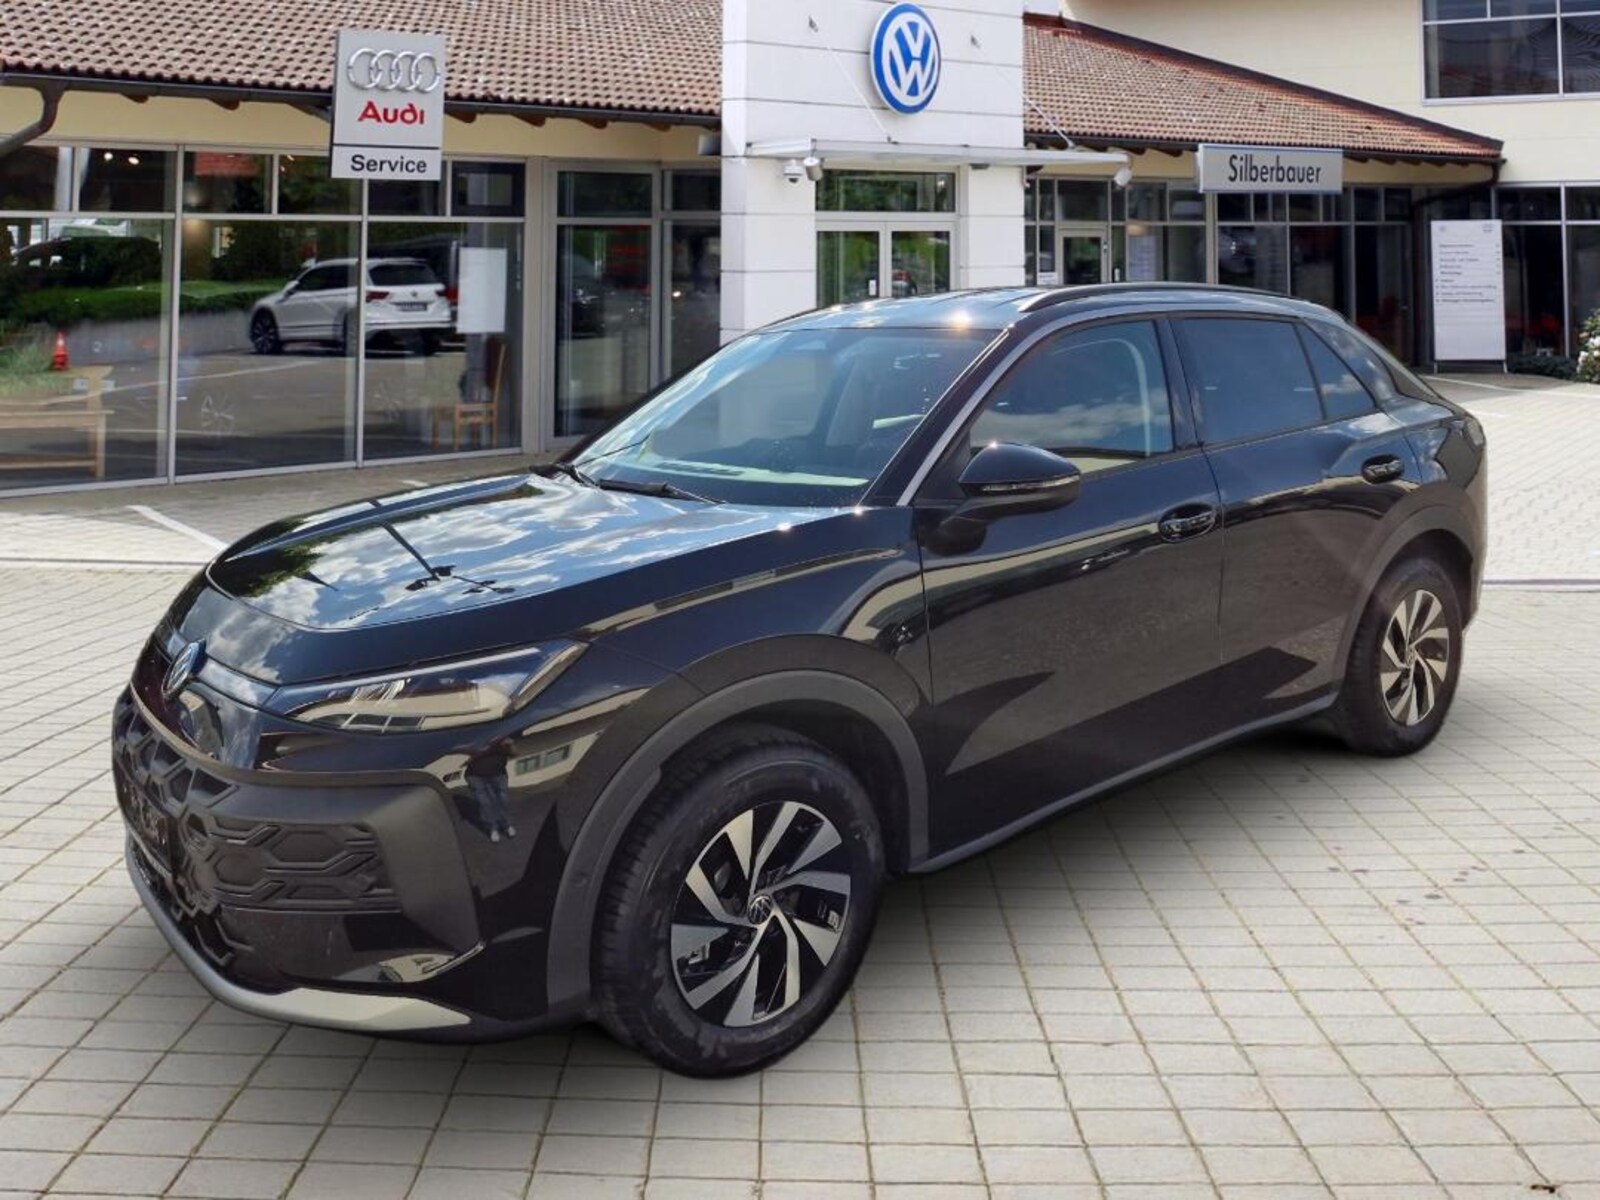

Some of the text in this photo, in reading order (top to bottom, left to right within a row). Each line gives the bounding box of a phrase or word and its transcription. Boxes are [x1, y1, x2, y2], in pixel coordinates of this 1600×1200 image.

[357, 100, 425, 125] Audi
[350, 154, 427, 173] Service
[1228, 154, 1322, 184] Silberbauer
